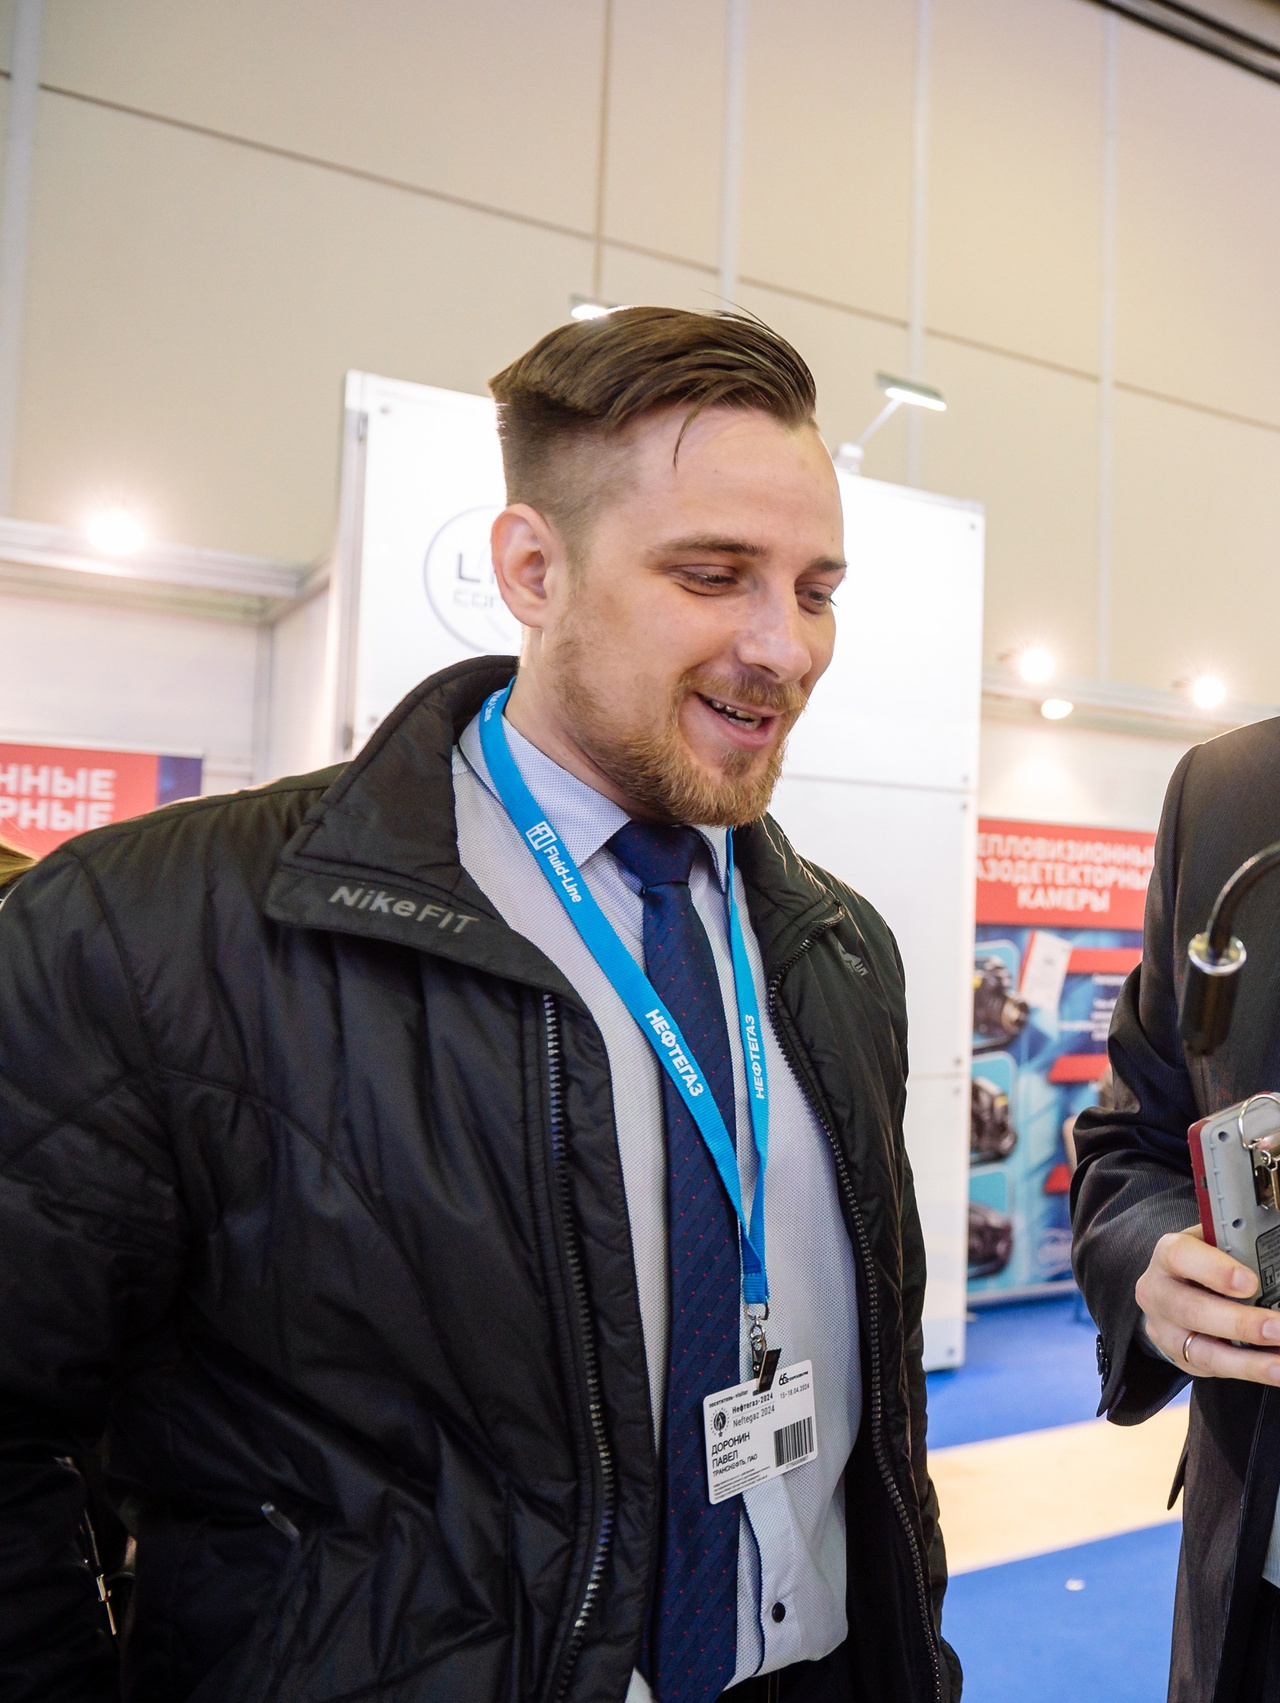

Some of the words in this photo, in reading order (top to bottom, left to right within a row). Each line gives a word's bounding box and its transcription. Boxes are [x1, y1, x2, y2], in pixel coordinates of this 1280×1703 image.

[543, 845, 582, 903] Fluid-Line
[328, 885, 479, 933] NikeFIT
[1018, 885, 1109, 913] КАМЕРЫ
[645, 1008, 704, 1097] НЕФТЕГАЗ
[745, 1014, 765, 1100] НЕФТЕГАЗ
[733, 1412, 760, 1428] Neftegaz
[761, 1405, 775, 1418] 2024
[711, 1431, 751, 1457] ДОРОНИН
[712, 1449, 739, 1469] ПАВЕЛ
